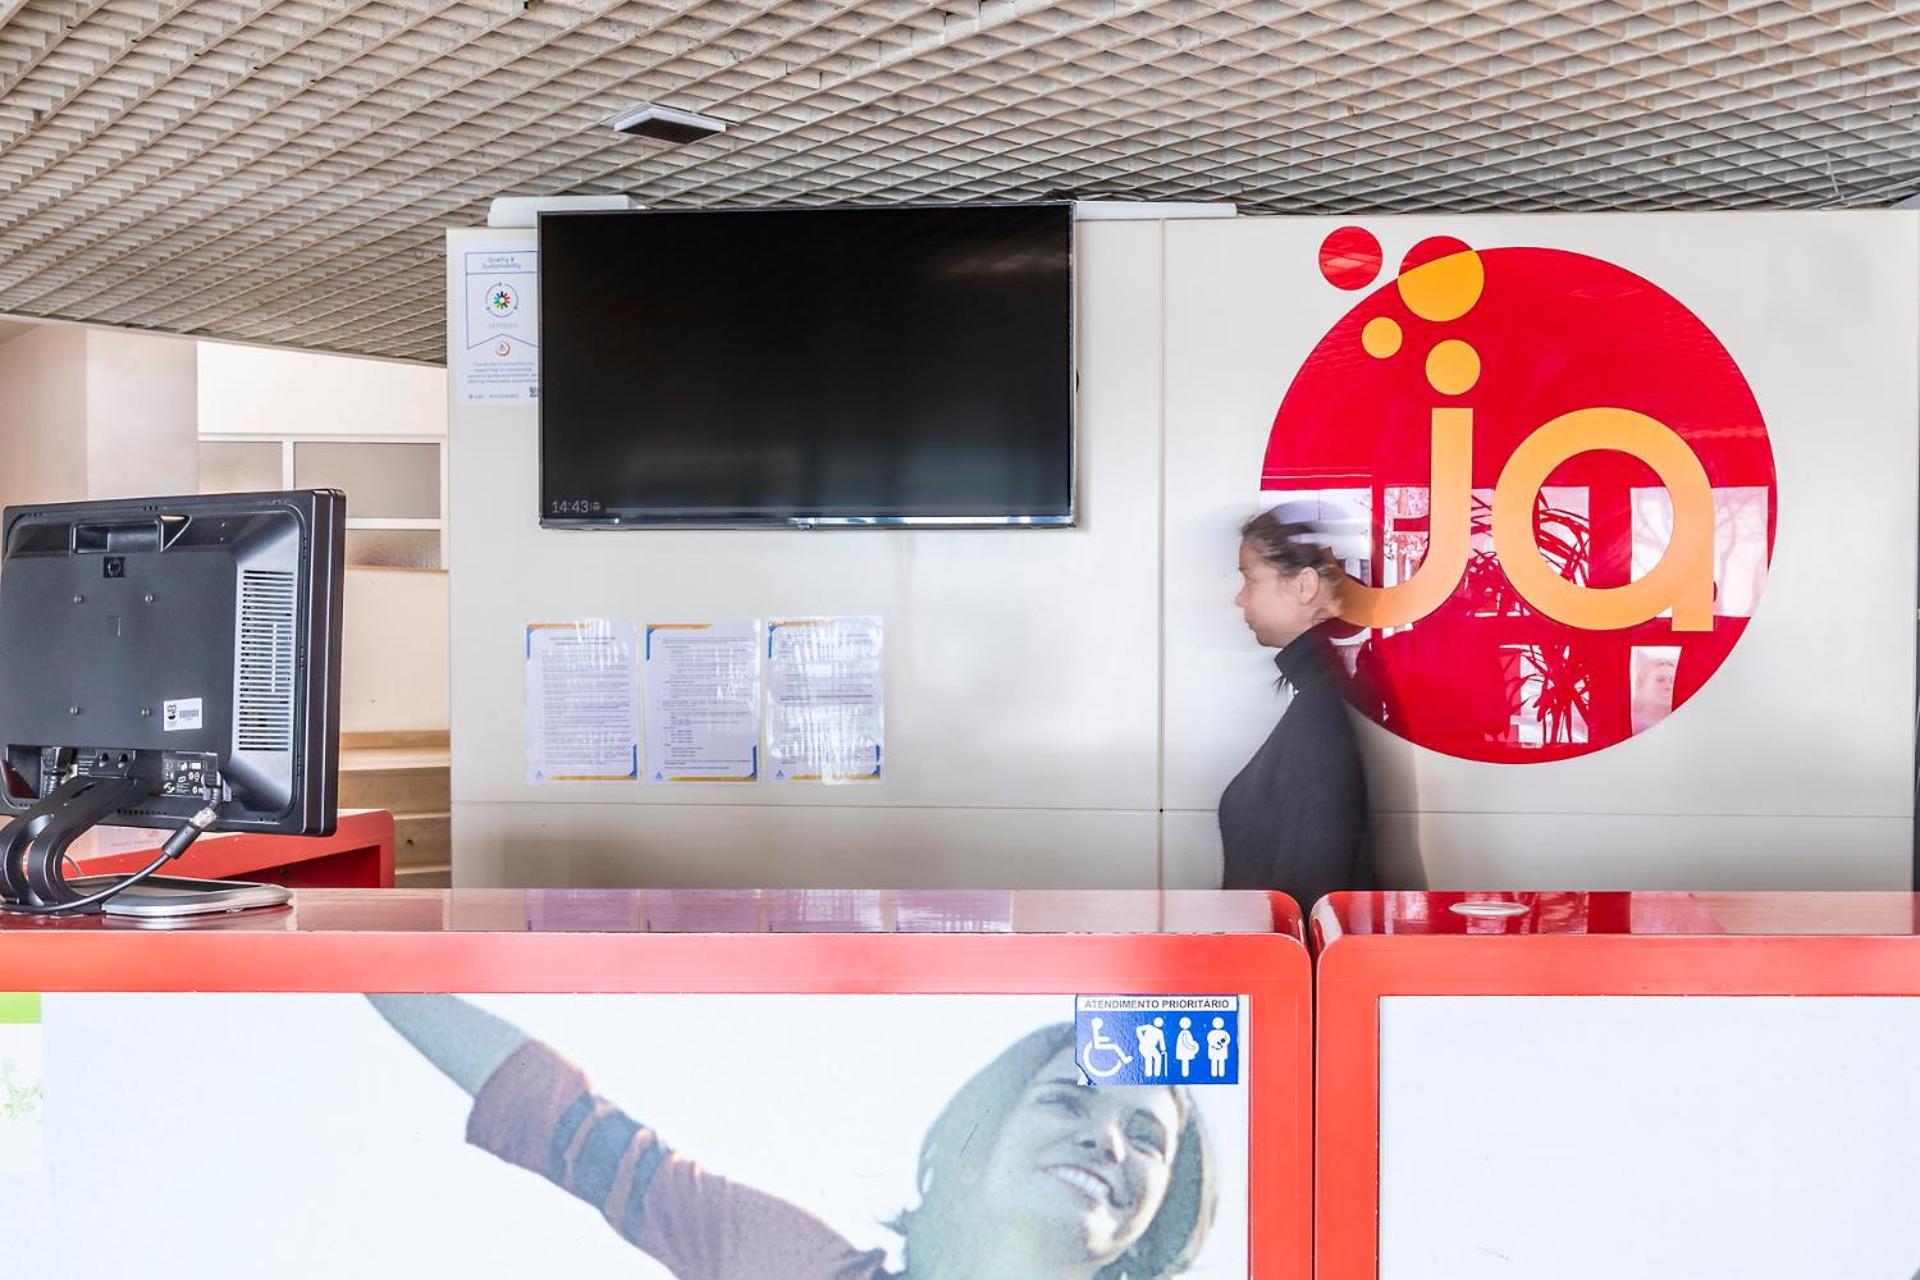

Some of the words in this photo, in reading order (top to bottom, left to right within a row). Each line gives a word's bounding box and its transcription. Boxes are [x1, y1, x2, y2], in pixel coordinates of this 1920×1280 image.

[552, 500, 589, 513] 14:43
[1085, 999, 1159, 1009] ATENDIMENTO
[1162, 998, 1230, 1009] PRIORITÁRIO
